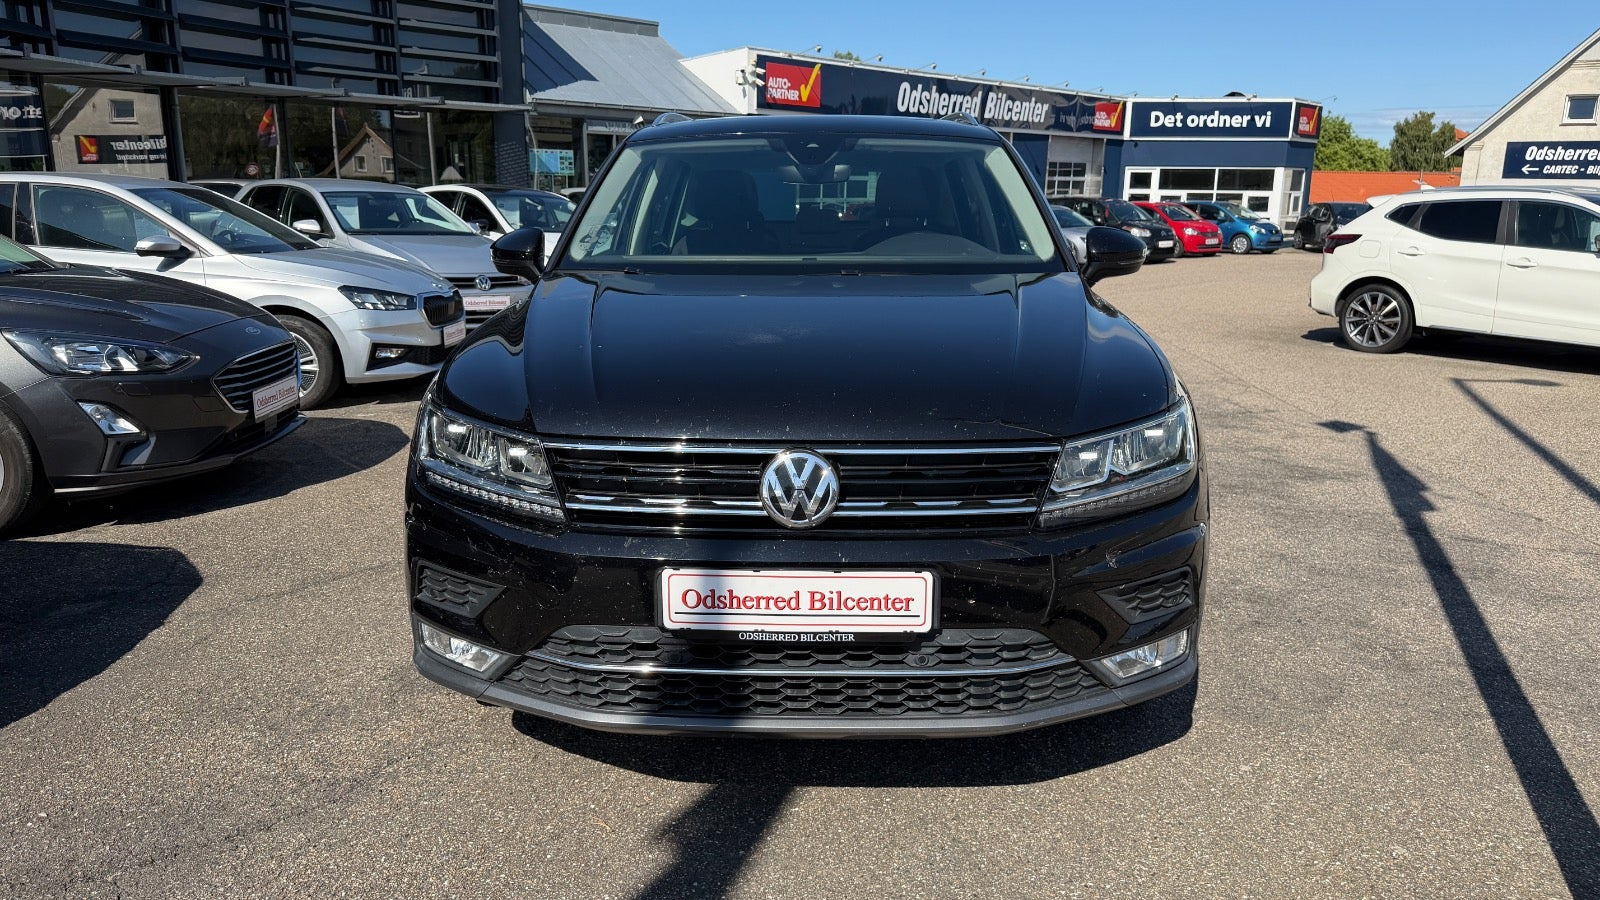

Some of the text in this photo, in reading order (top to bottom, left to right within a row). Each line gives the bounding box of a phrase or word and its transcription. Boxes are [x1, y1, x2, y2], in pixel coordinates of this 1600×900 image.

[768, 76, 791, 89] AUTO-
[767, 87, 800, 101] PARTNER
[897, 81, 980, 118] Odsherred
[984, 91, 1049, 123] Bilcenter
[1150, 111, 1272, 128] Det ordner vi
[1543, 165, 1579, 174] CARTEC
[681, 588, 914, 612] Odsherred Bilcenter
[738, 632, 855, 642] ODSHERRED BILCENTER
